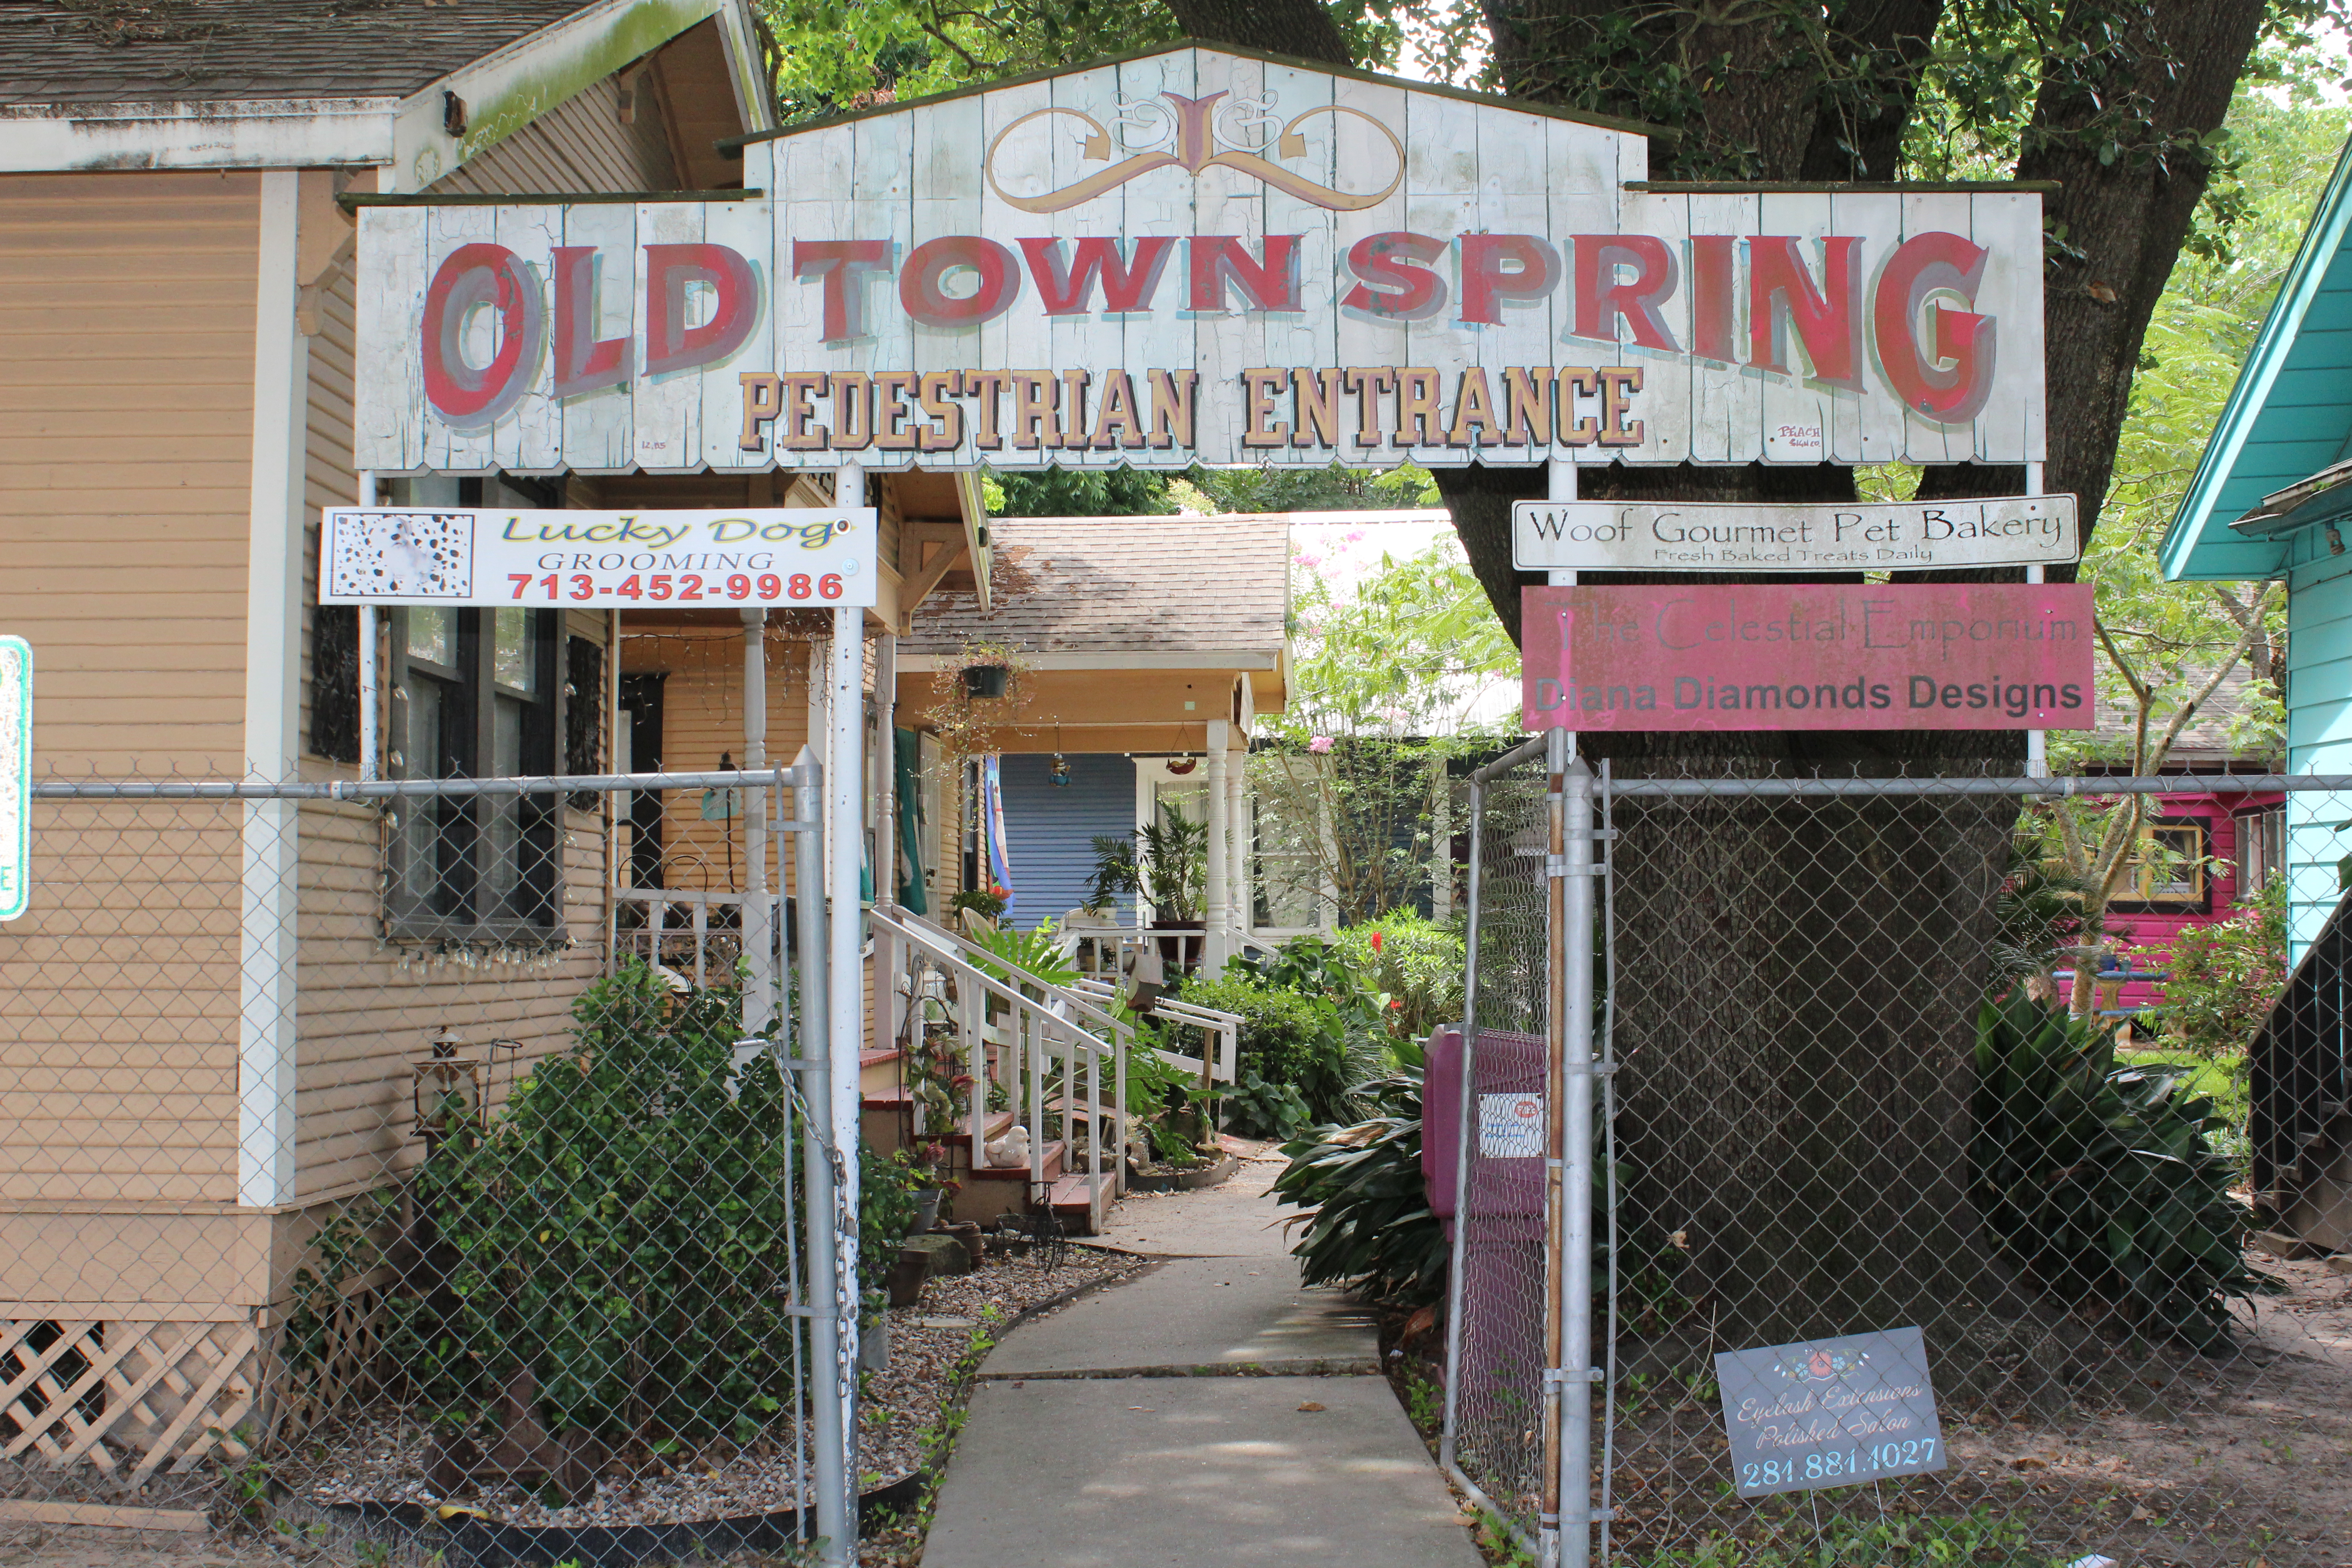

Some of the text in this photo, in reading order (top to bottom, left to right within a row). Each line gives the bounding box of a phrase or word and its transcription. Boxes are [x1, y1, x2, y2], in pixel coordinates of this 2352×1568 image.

[421, 231, 1996, 433] OLD TOWN SPRING
[739, 367, 1643, 450] PEDESTRIAN ENTRANCE
[1777, 425, 1821, 437] PEACH
[502, 515, 858, 550] Lucky Dog
[1530, 505, 2060, 548] Woof Gourmet Pet Bakery
[538, 553, 775, 571] GROOMING
[1655, 545, 1932, 564] Fresh Baked Treats Daily
[507, 573, 843, 601] 713-452-9986
[1545, 598, 2077, 662] The Celestial Emporium
[1535, 675, 2082, 718] Diana Diamonds Designs
[1737, 1383, 1922, 1428] Eyelash Extensions
[1756, 1408, 1911, 1449] Polished Salon
[1743, 1437, 1936, 1489] 281.881.1027
